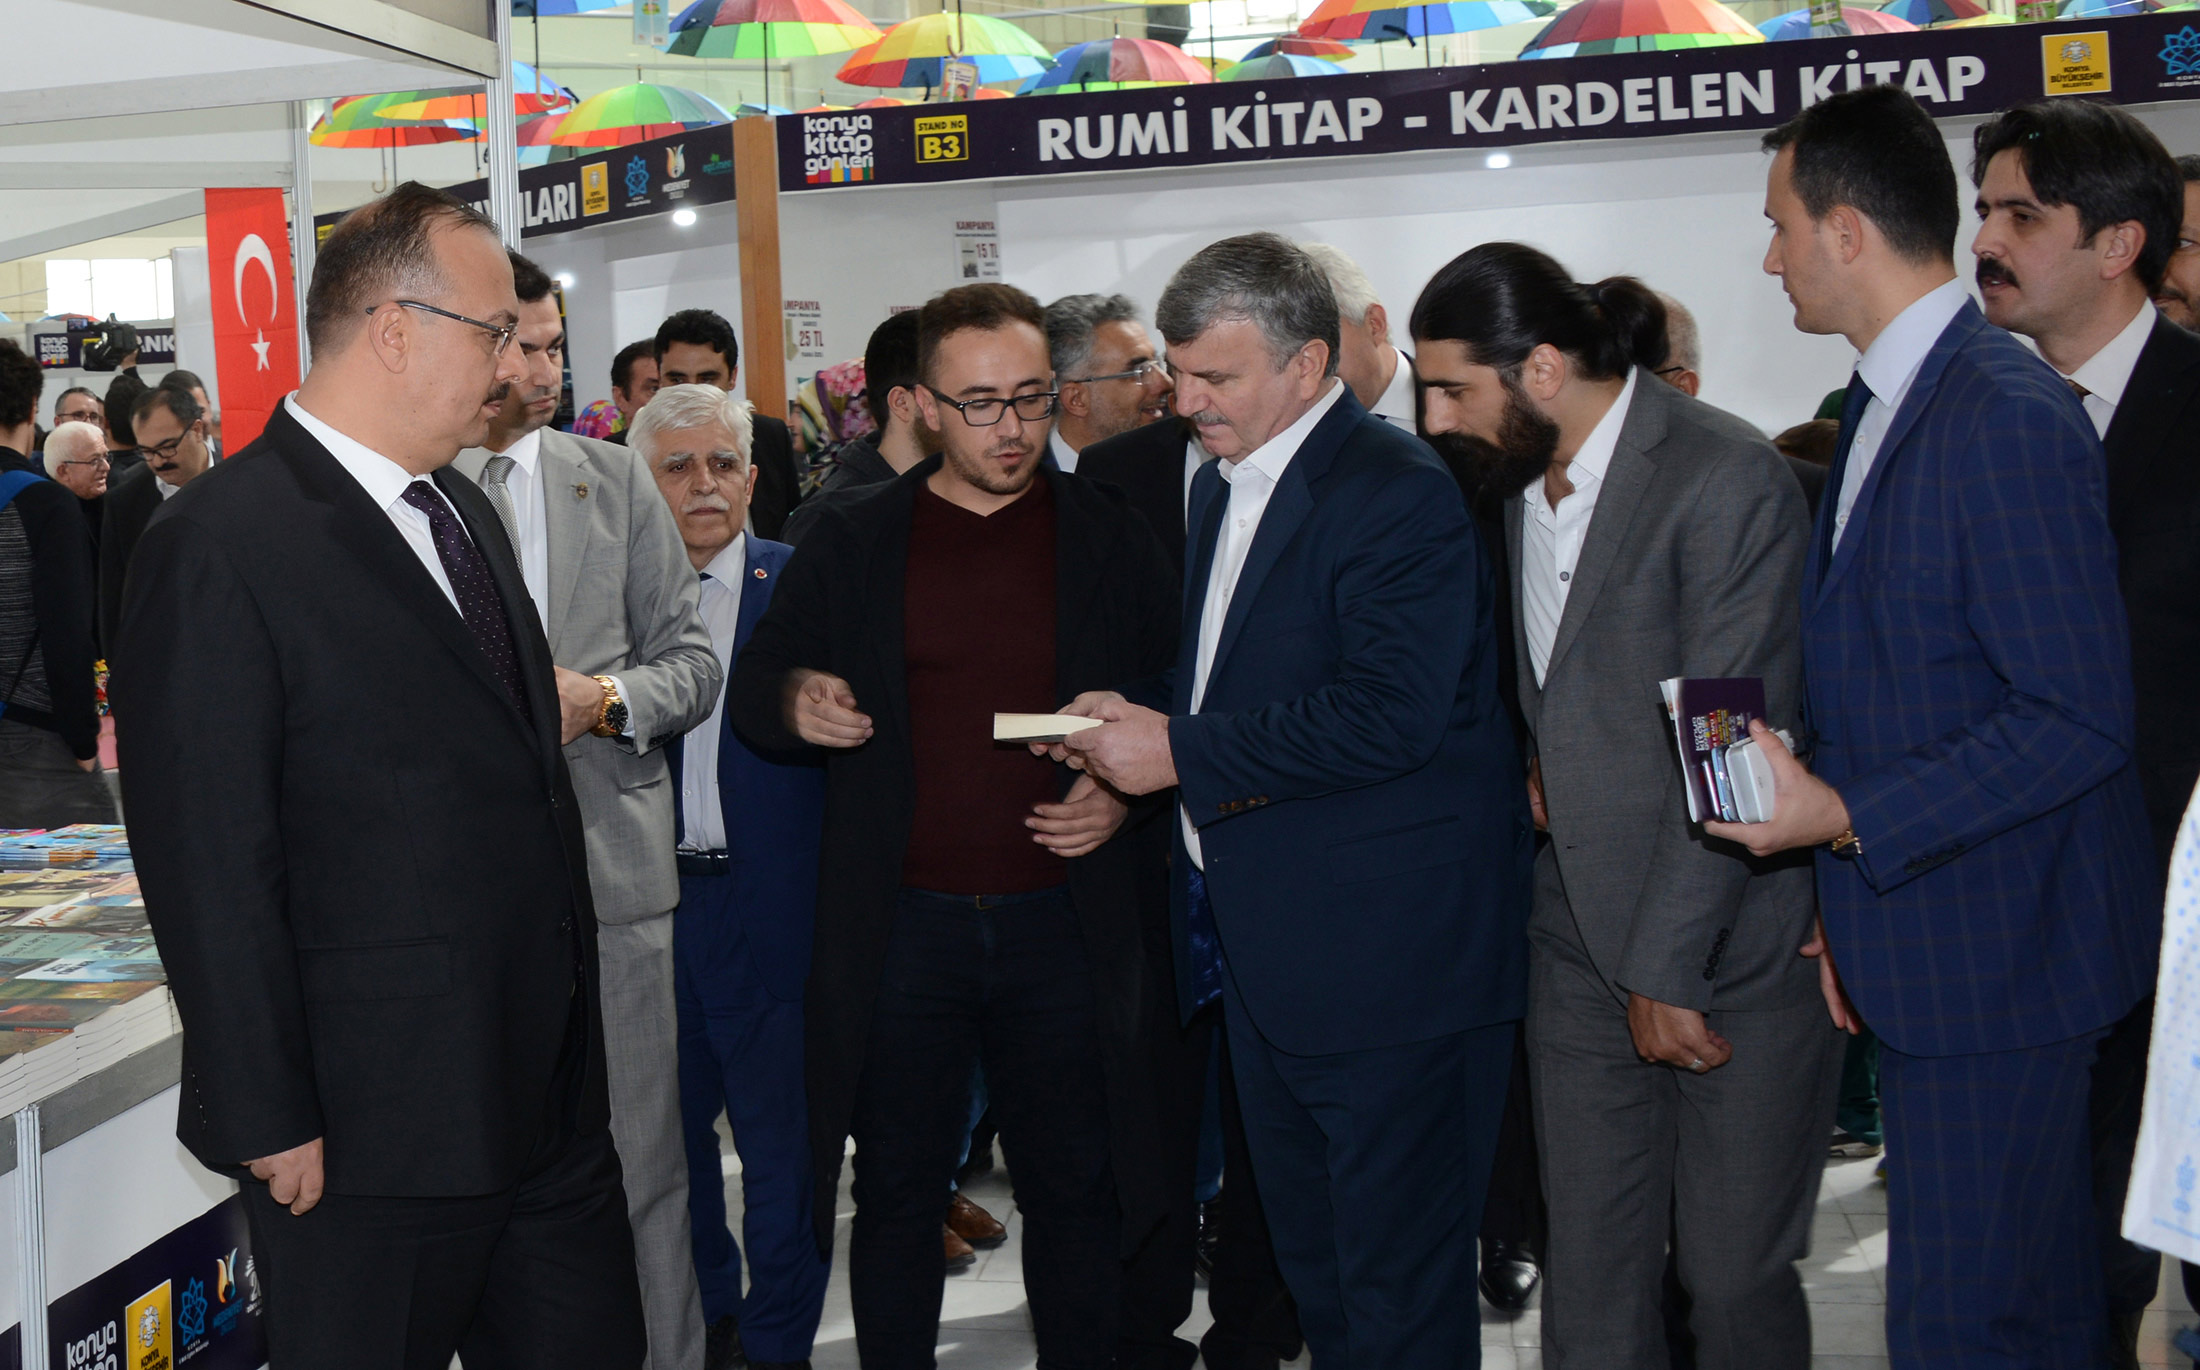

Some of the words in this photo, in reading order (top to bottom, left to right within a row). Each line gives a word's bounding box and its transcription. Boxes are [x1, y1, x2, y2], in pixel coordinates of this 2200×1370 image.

[803, 115, 873, 136] konya
[918, 121, 948, 132] STAND
[950, 119, 965, 130] NO
[1037, 96, 1189, 162] RUMİ
[1211, 91, 1383, 151] KİTAP
[1404, 115, 1427, 128] -
[1450, 69, 1776, 135] KARDELEN
[804, 133, 874, 156] kitap
[922, 135, 961, 160] B3
[805, 152, 874, 176] günleri
[976, 243, 987, 258] 15
[989, 243, 999, 258] TL
[799, 330, 811, 347] 25
[813, 330, 824, 347] TL
[67, 1320, 117, 1370] konya
